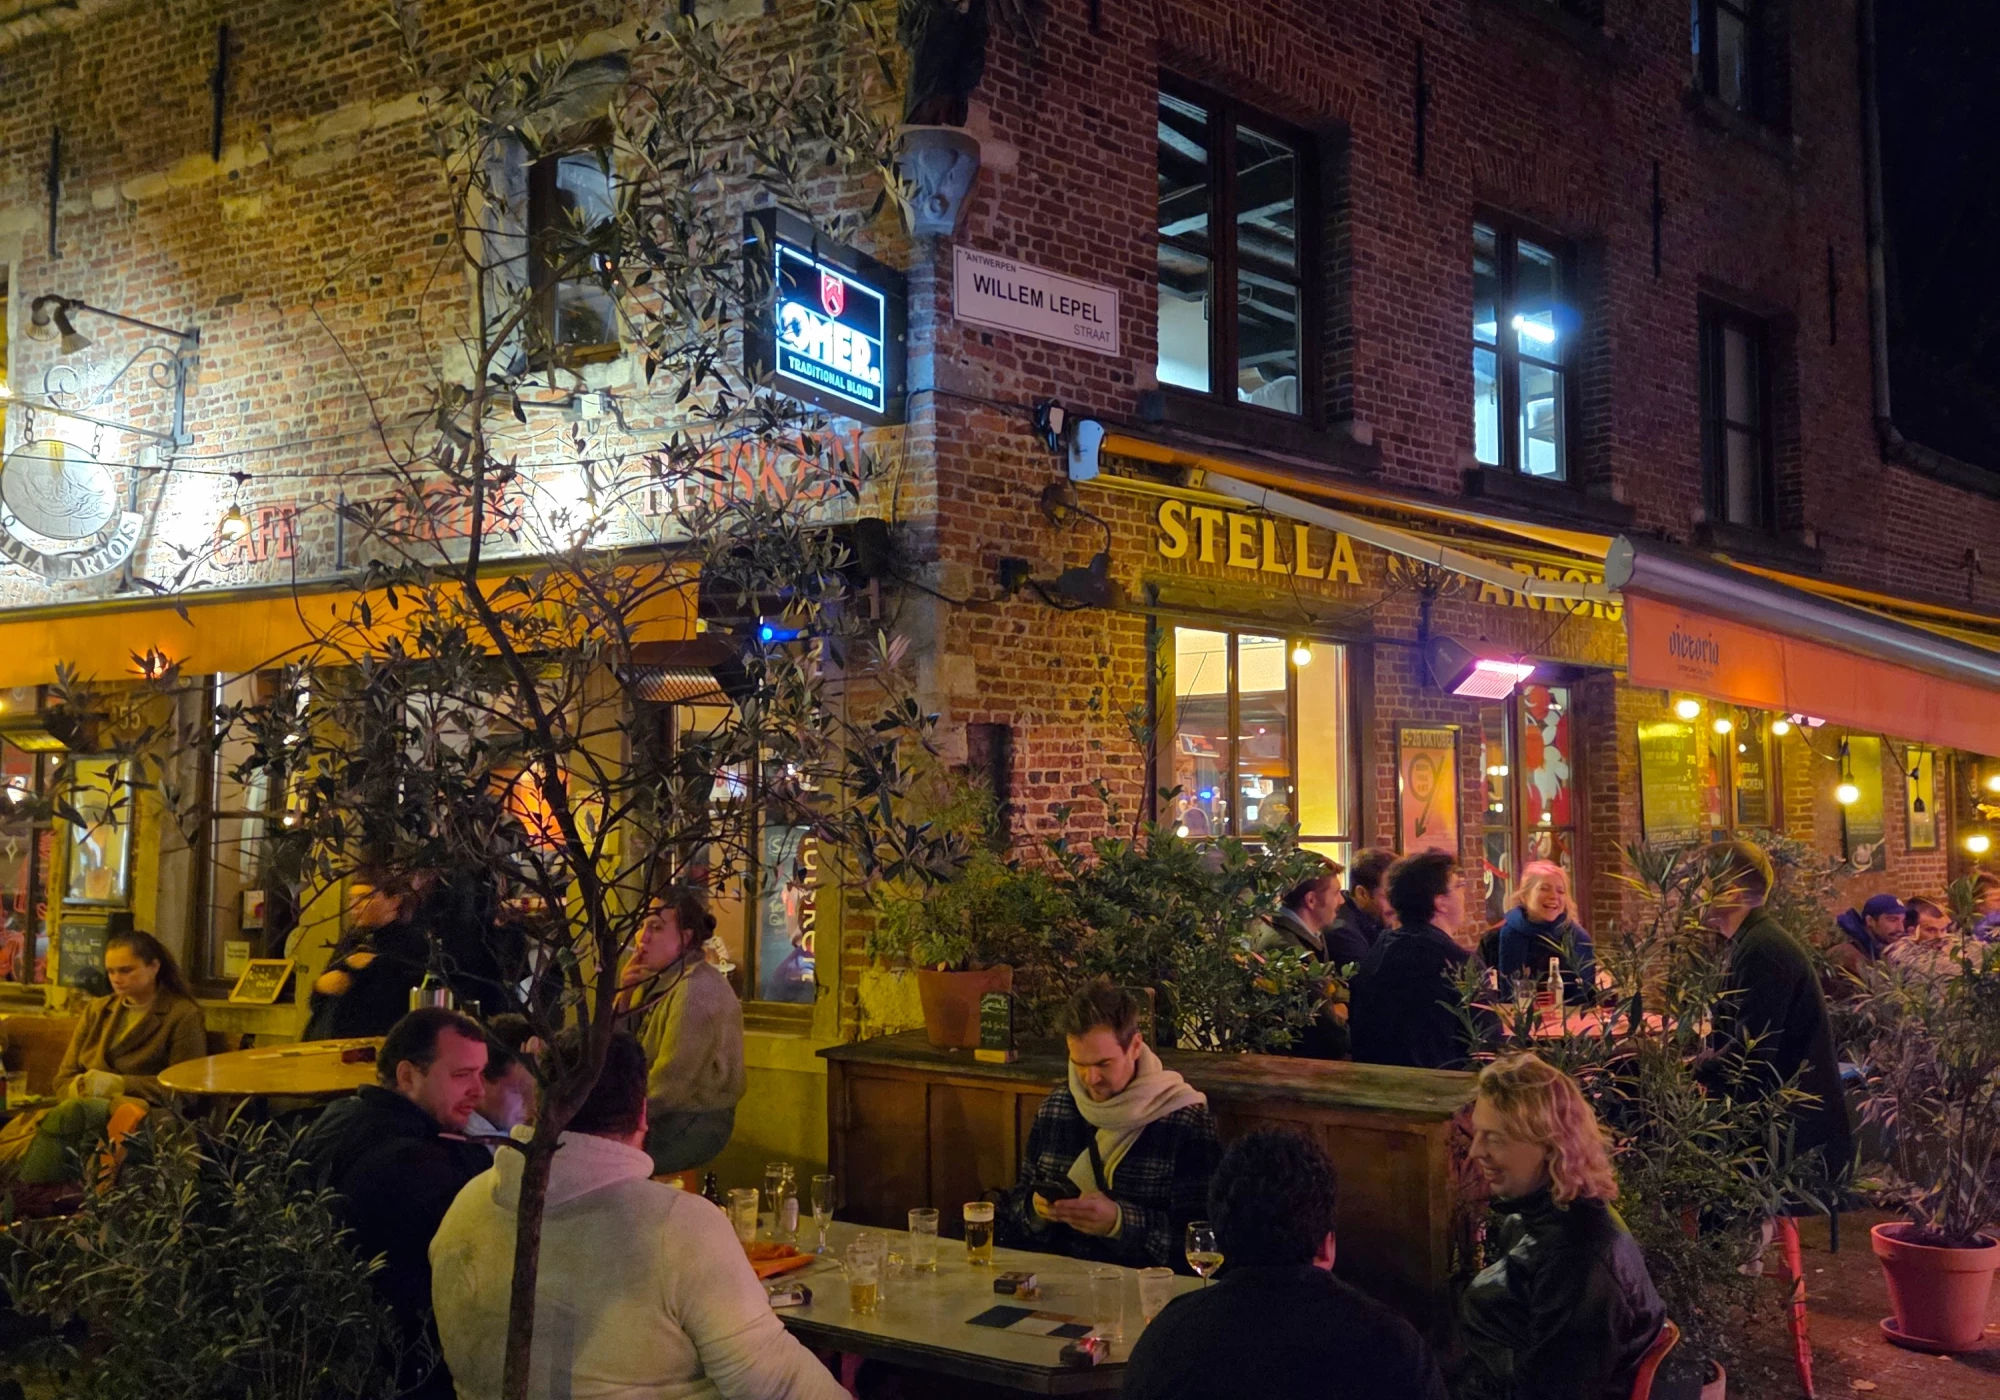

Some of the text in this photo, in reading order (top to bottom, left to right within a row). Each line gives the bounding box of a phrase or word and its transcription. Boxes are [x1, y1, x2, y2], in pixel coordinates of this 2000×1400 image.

[973, 273, 1103, 324] WILLEM LEPEL
[1073, 324, 1111, 344] STRAAT
[788, 355, 874, 402] TRADITIONAL BLOND
[70, 520, 138, 577] ARTOIS
[213, 503, 297, 565] CAFE
[1158, 500, 1364, 585] STELLA
[1668, 623, 1719, 666] victoria
